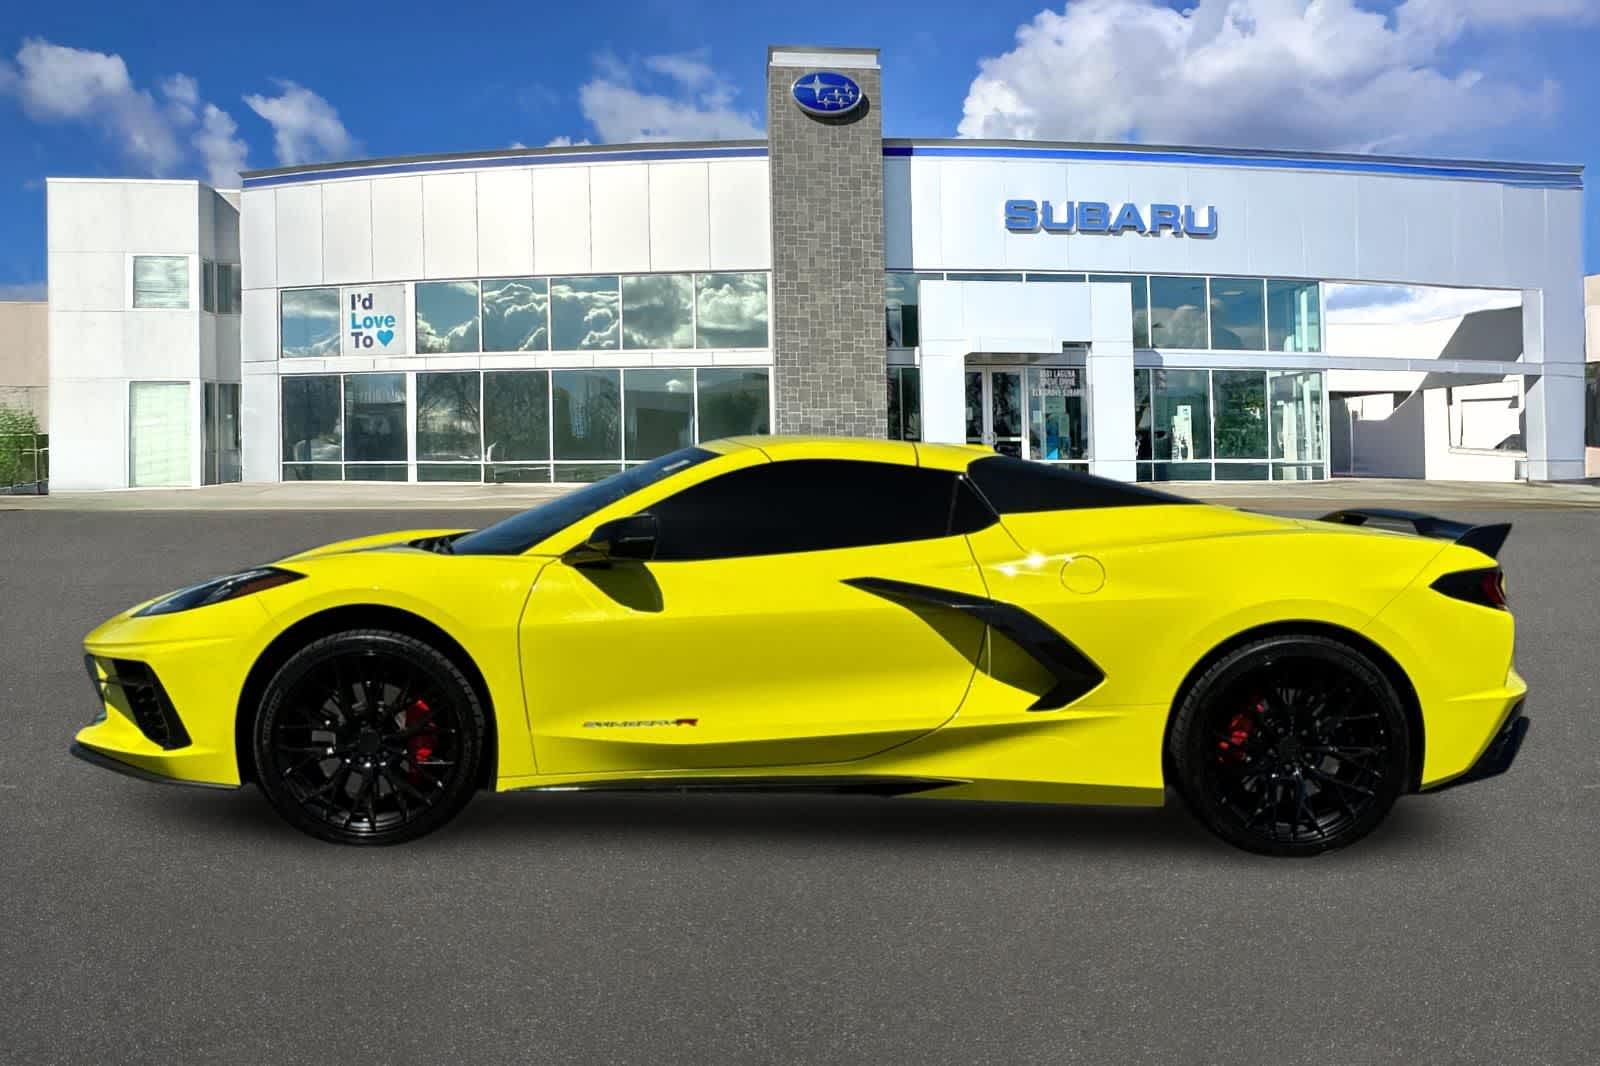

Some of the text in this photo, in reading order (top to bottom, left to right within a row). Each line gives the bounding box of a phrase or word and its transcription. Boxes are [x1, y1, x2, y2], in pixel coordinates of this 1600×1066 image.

[1004, 199, 1218, 239] SUBARU
[351, 293, 373, 310] I'd
[351, 312, 396, 329] Love
[351, 331, 374, 348] To
